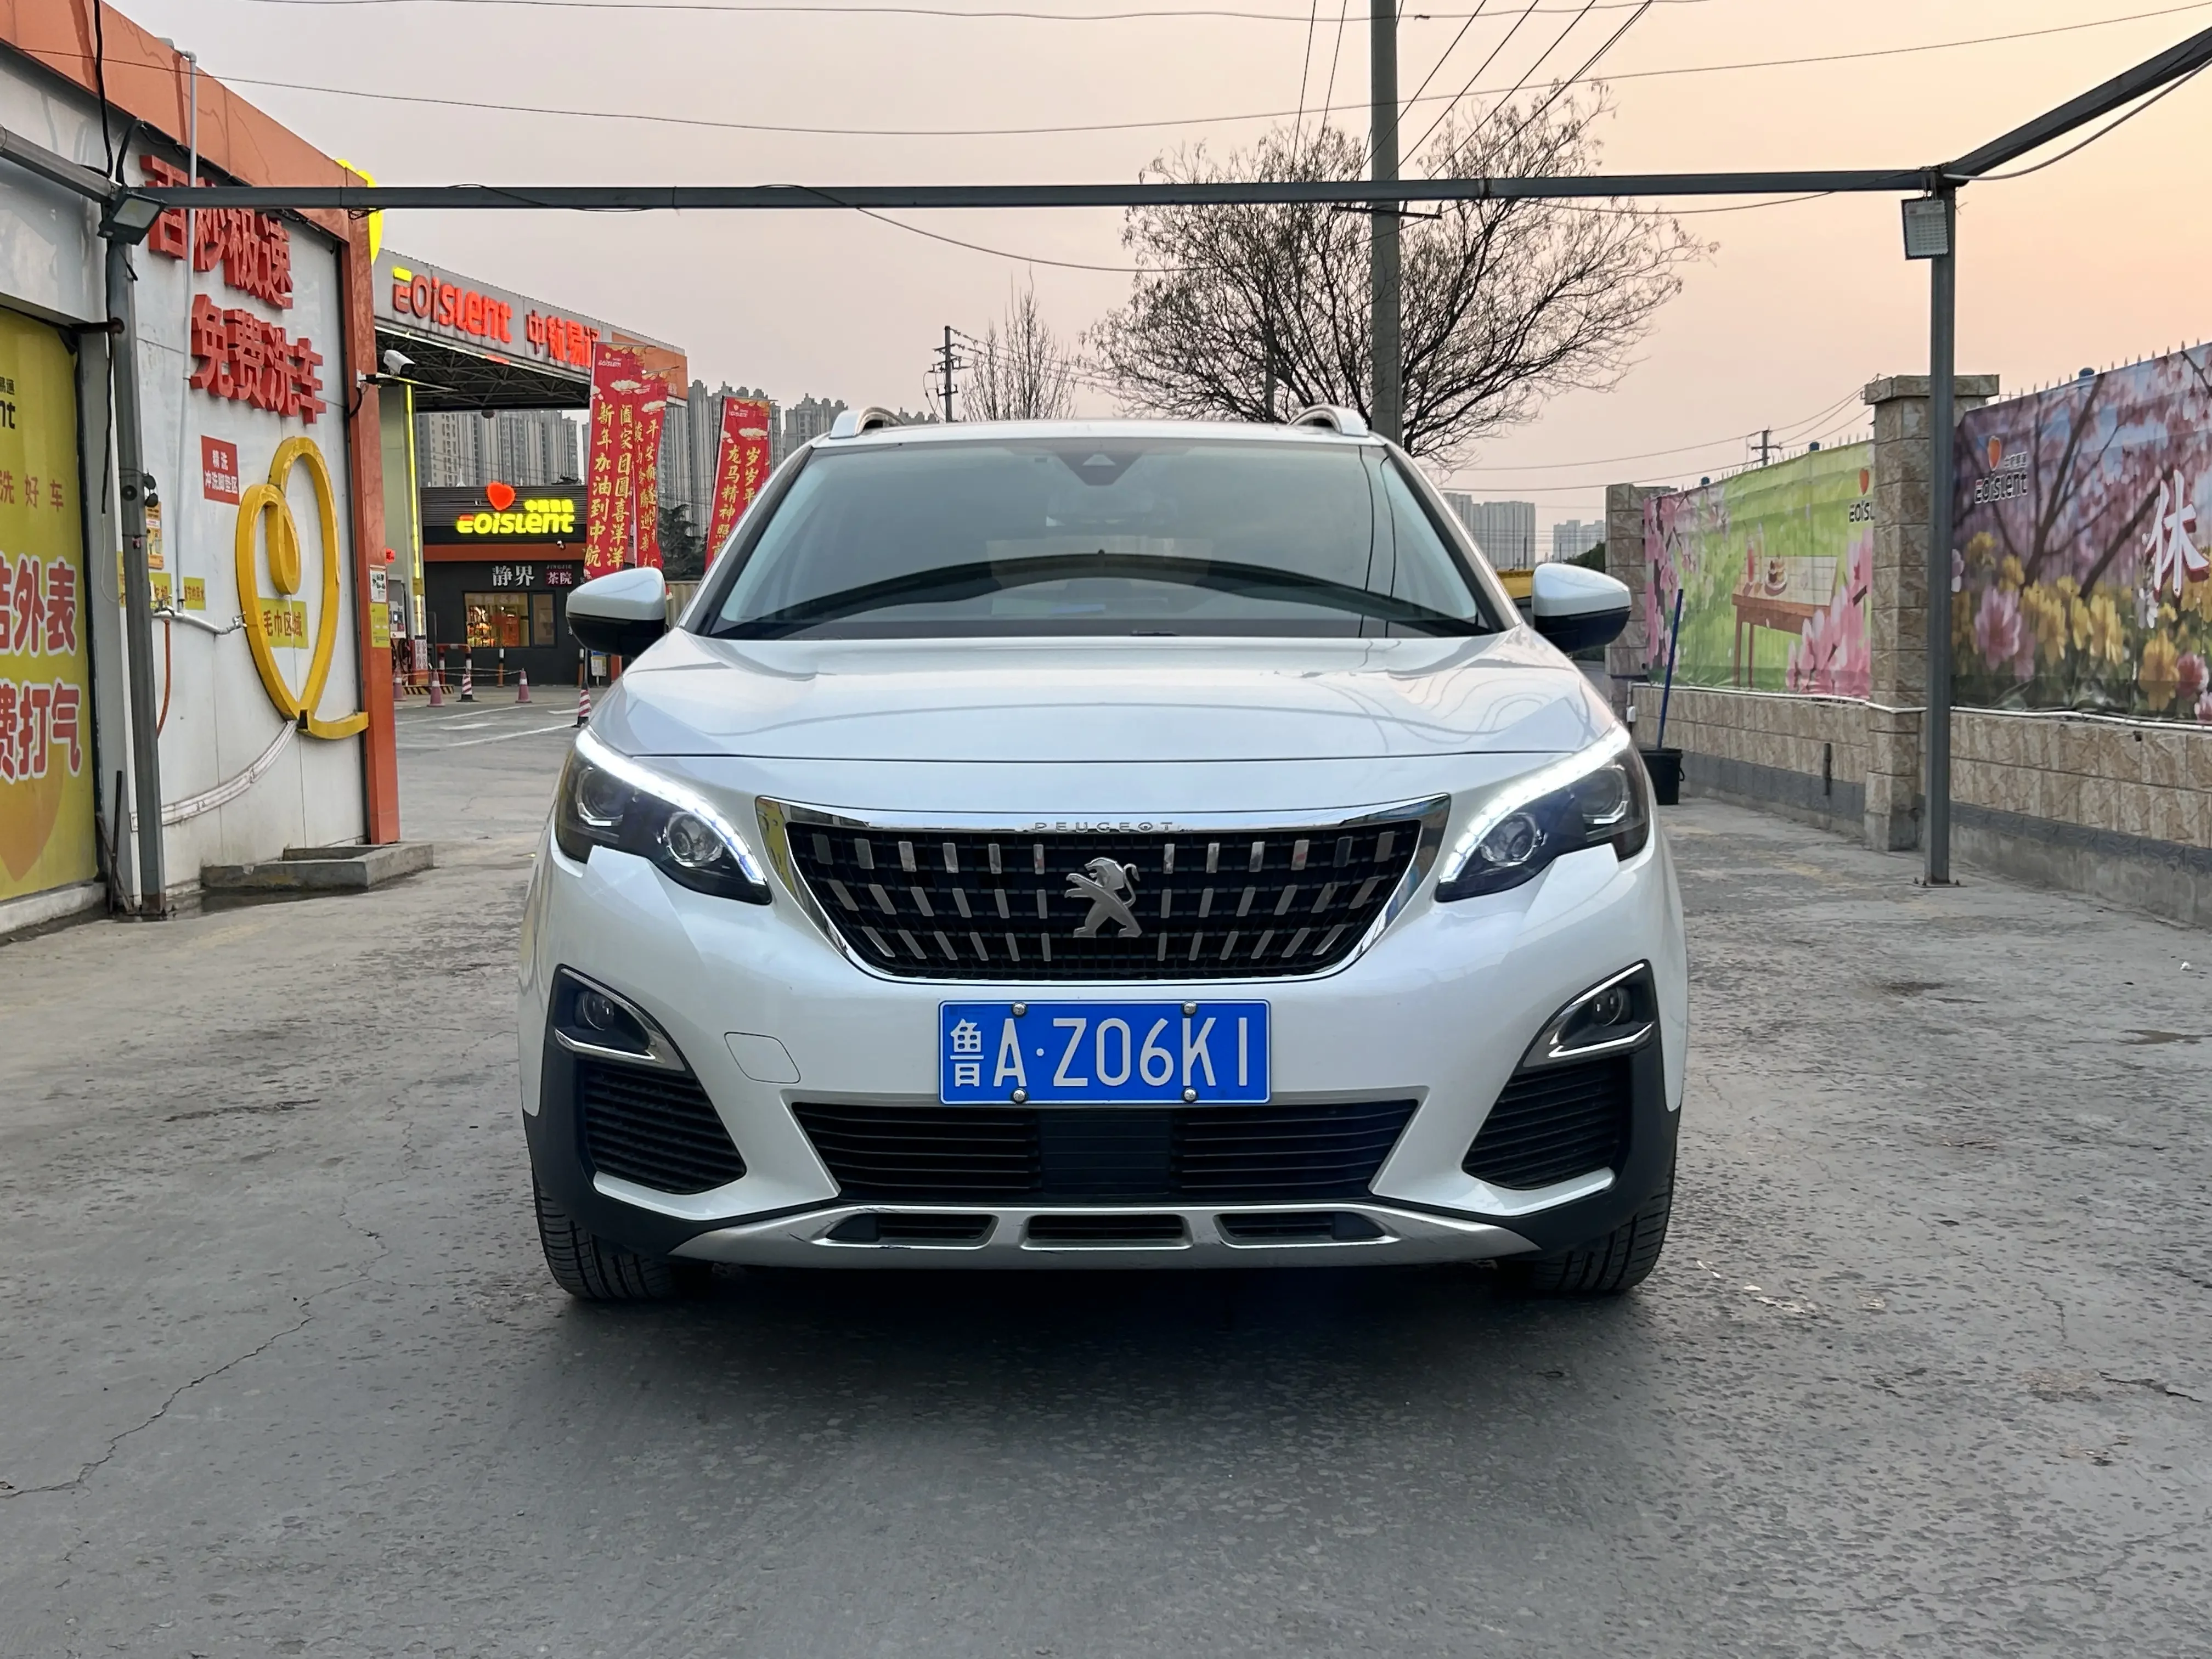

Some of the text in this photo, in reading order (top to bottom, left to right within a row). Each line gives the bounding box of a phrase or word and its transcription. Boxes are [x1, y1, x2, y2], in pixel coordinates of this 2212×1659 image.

[190, 294, 326, 424] 免费洗车
[585, 402, 614, 567] 新年加油到中航
[2146, 469, 2210, 598] 休
[492, 565, 535, 586] 静界
[548, 571, 573, 585] 茶院
[263, 610, 302, 637] 毛巾区域
[1035, 822, 1173, 833] PEUGEOT
